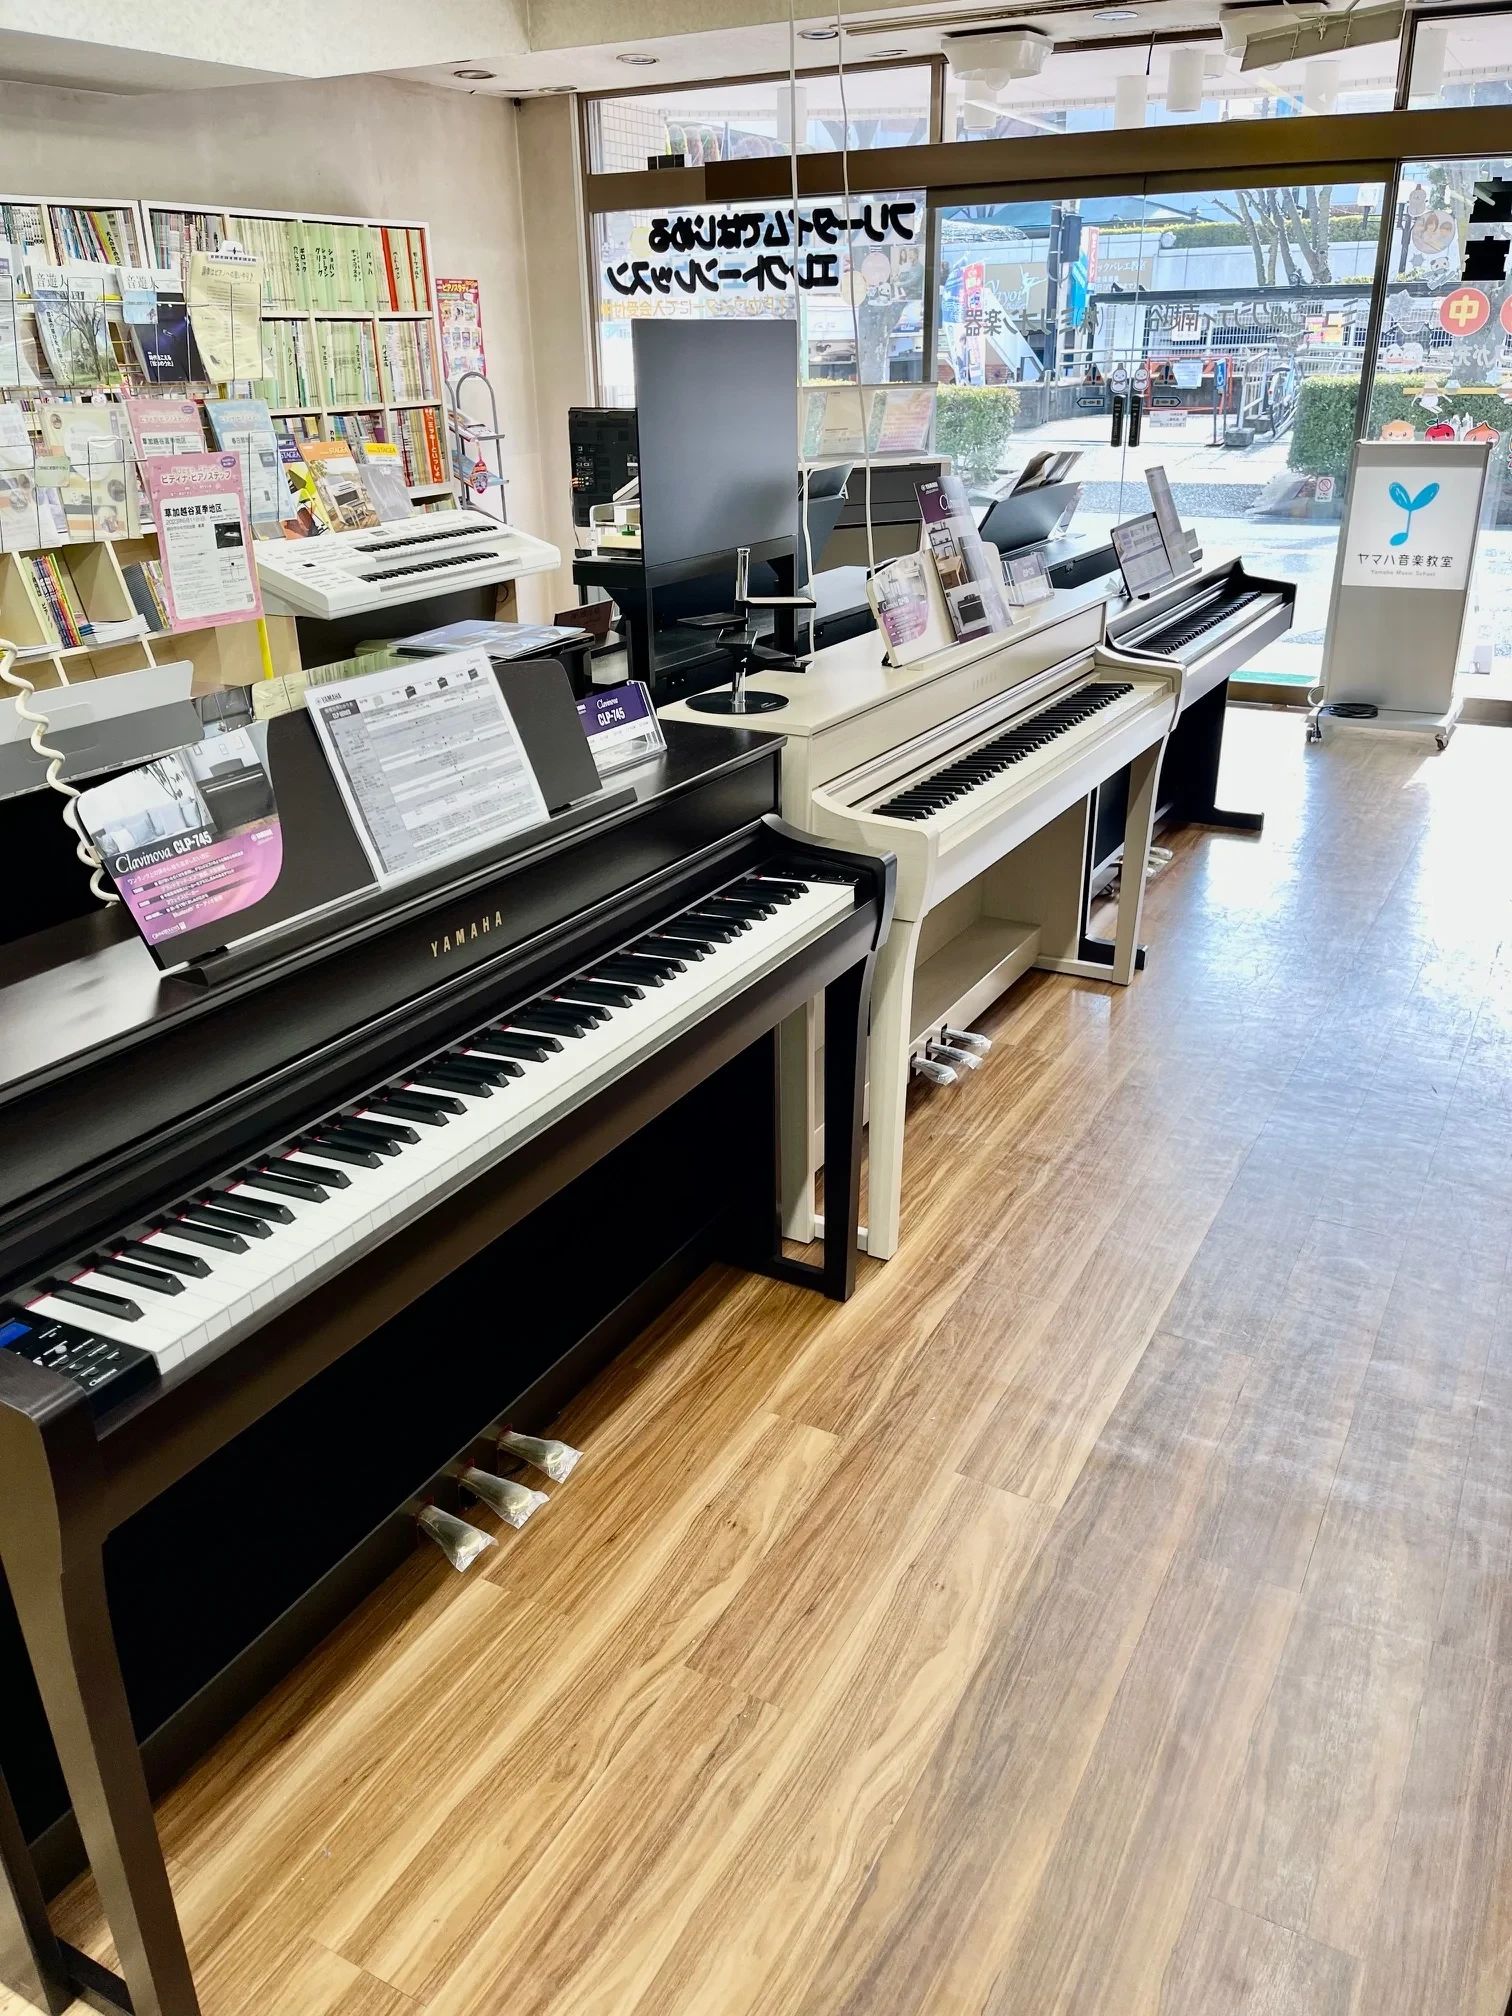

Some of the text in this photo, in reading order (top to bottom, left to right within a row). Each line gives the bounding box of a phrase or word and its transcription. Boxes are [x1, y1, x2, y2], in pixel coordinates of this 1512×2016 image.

[164, 503, 223, 517] 草加越谷夏季地区
[1357, 553, 1454, 568] ヤマハ音楽教室
[321, 691, 342, 702] YAMAHA
[597, 707, 626, 727] CLP-745
[115, 846, 172, 874] Clavinova
[172, 830, 213, 854] CLP-745
[431, 911, 502, 957] YAMAHA
